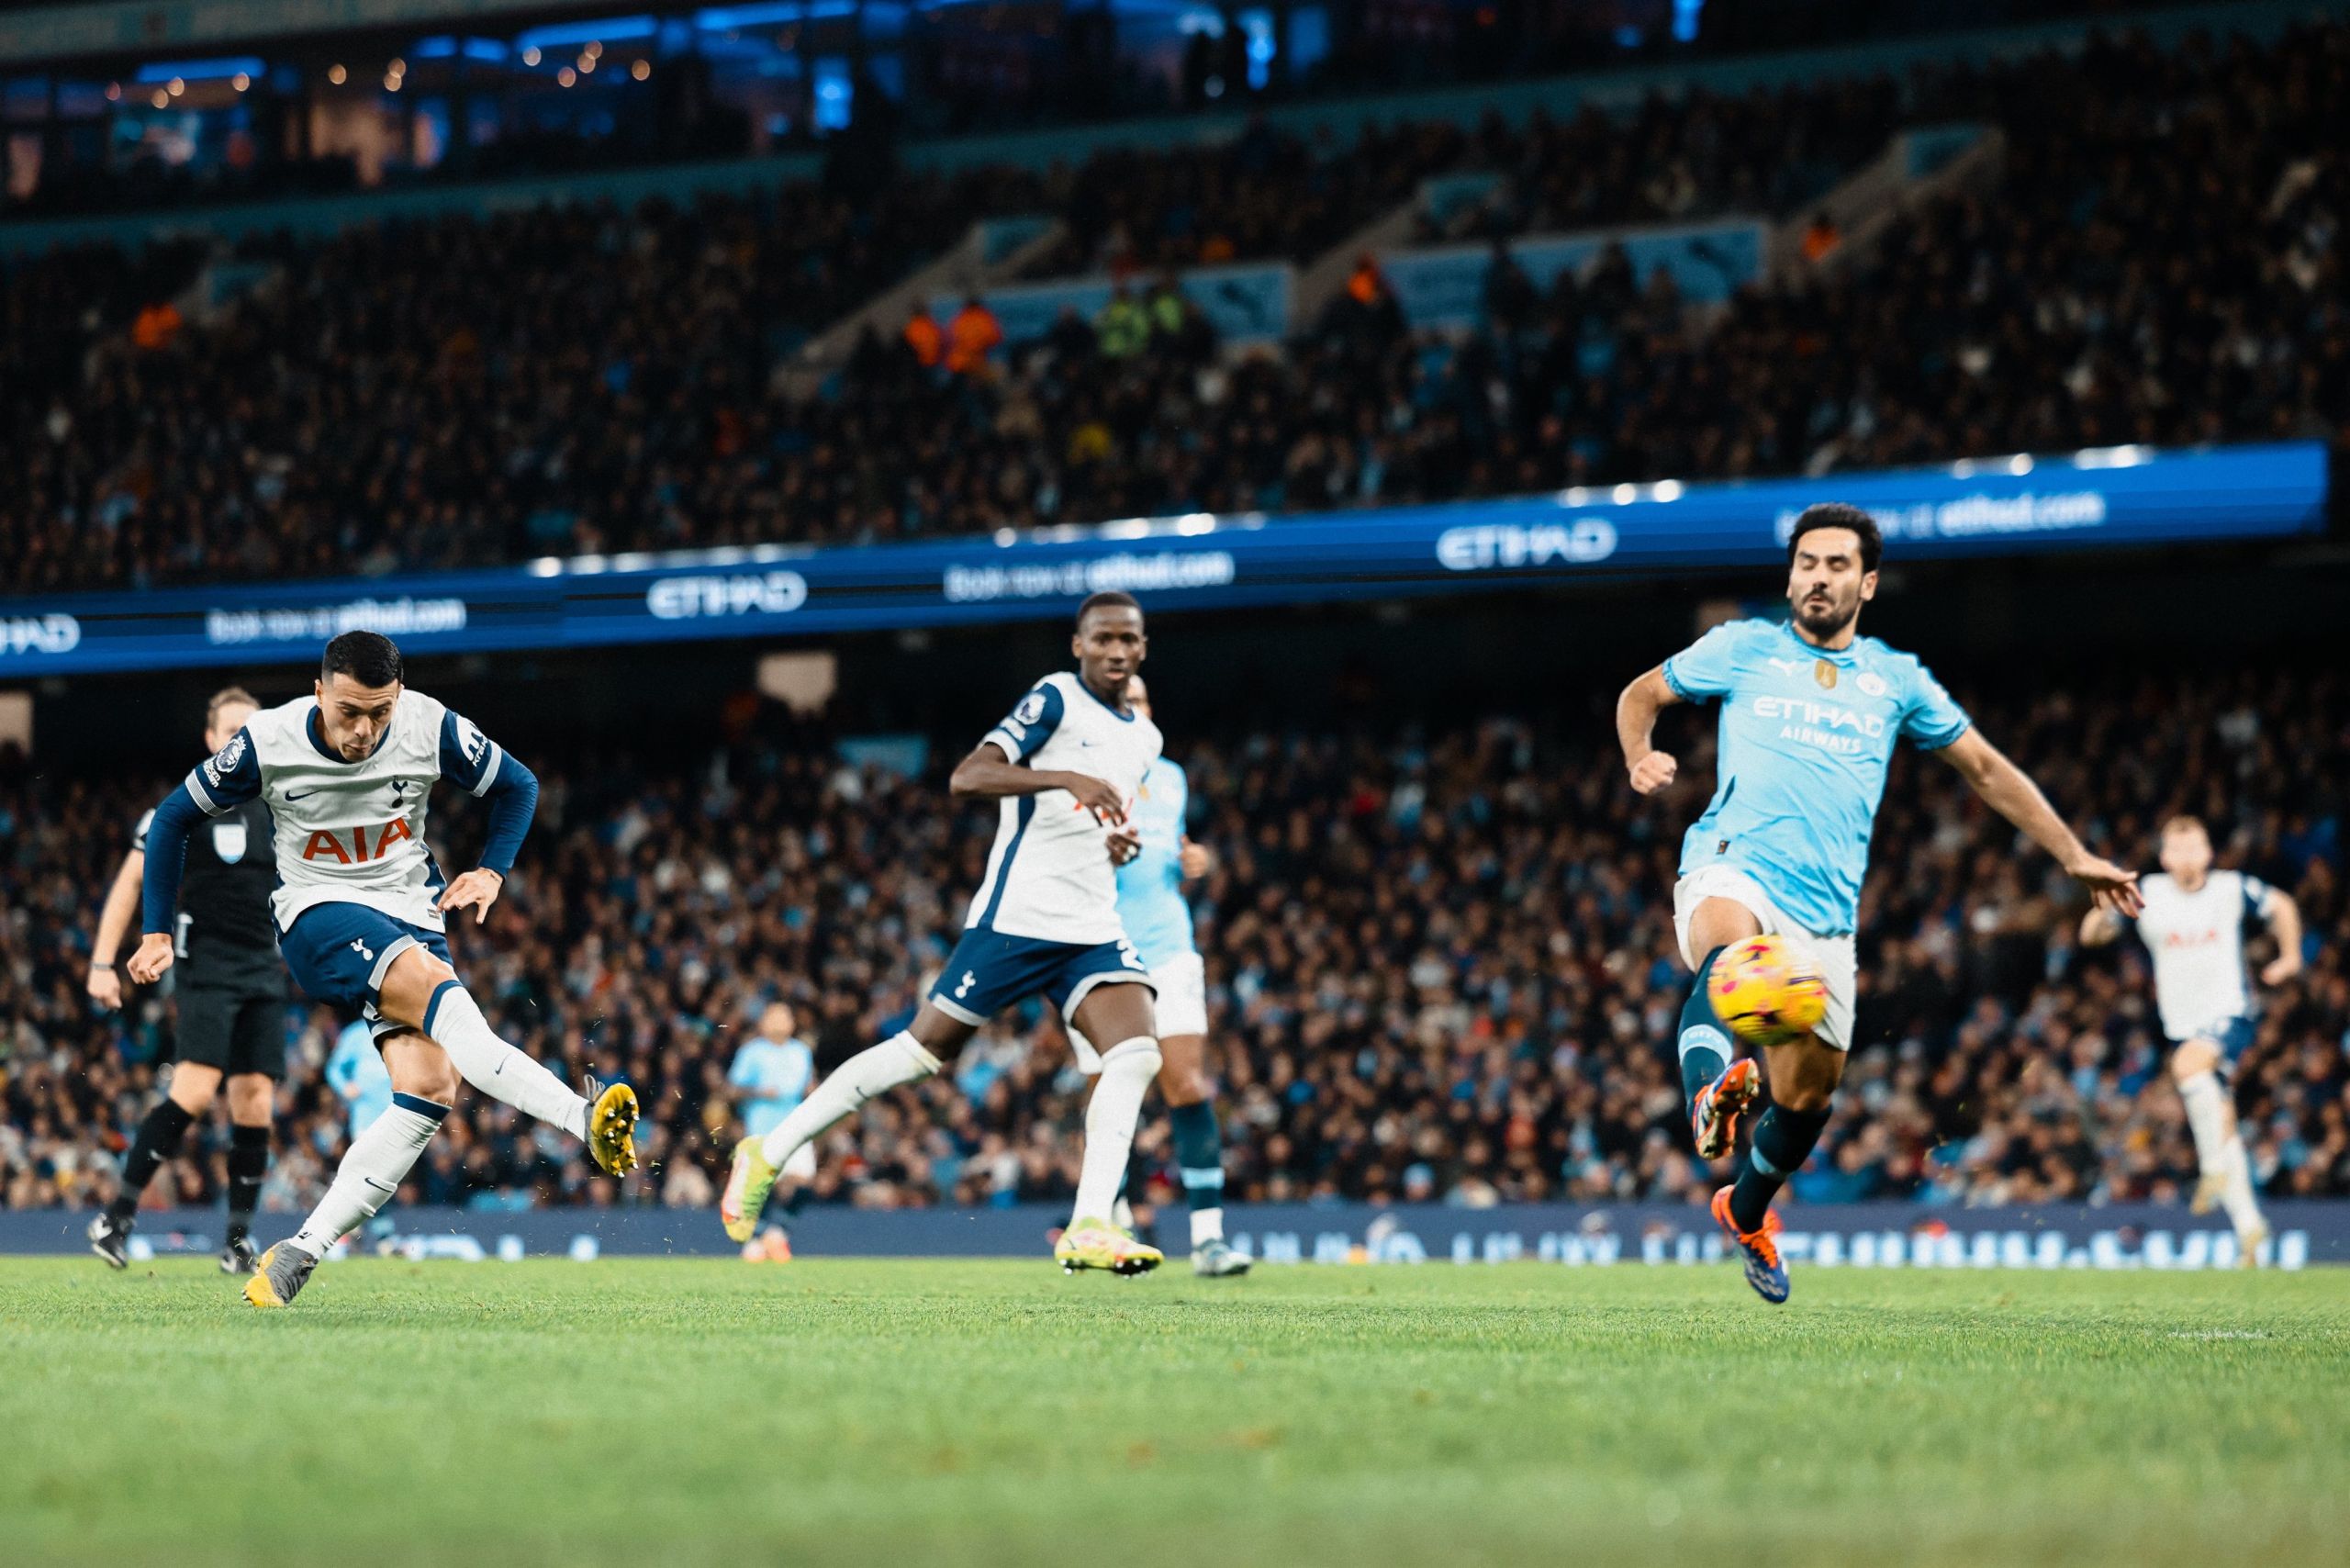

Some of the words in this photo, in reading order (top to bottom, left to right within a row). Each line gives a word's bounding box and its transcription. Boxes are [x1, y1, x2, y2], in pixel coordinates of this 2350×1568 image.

[1753, 695, 1884, 738] ETIHAD
[1779, 725, 1862, 753] AIRWAYS
[303, 817, 412, 864] AIA
